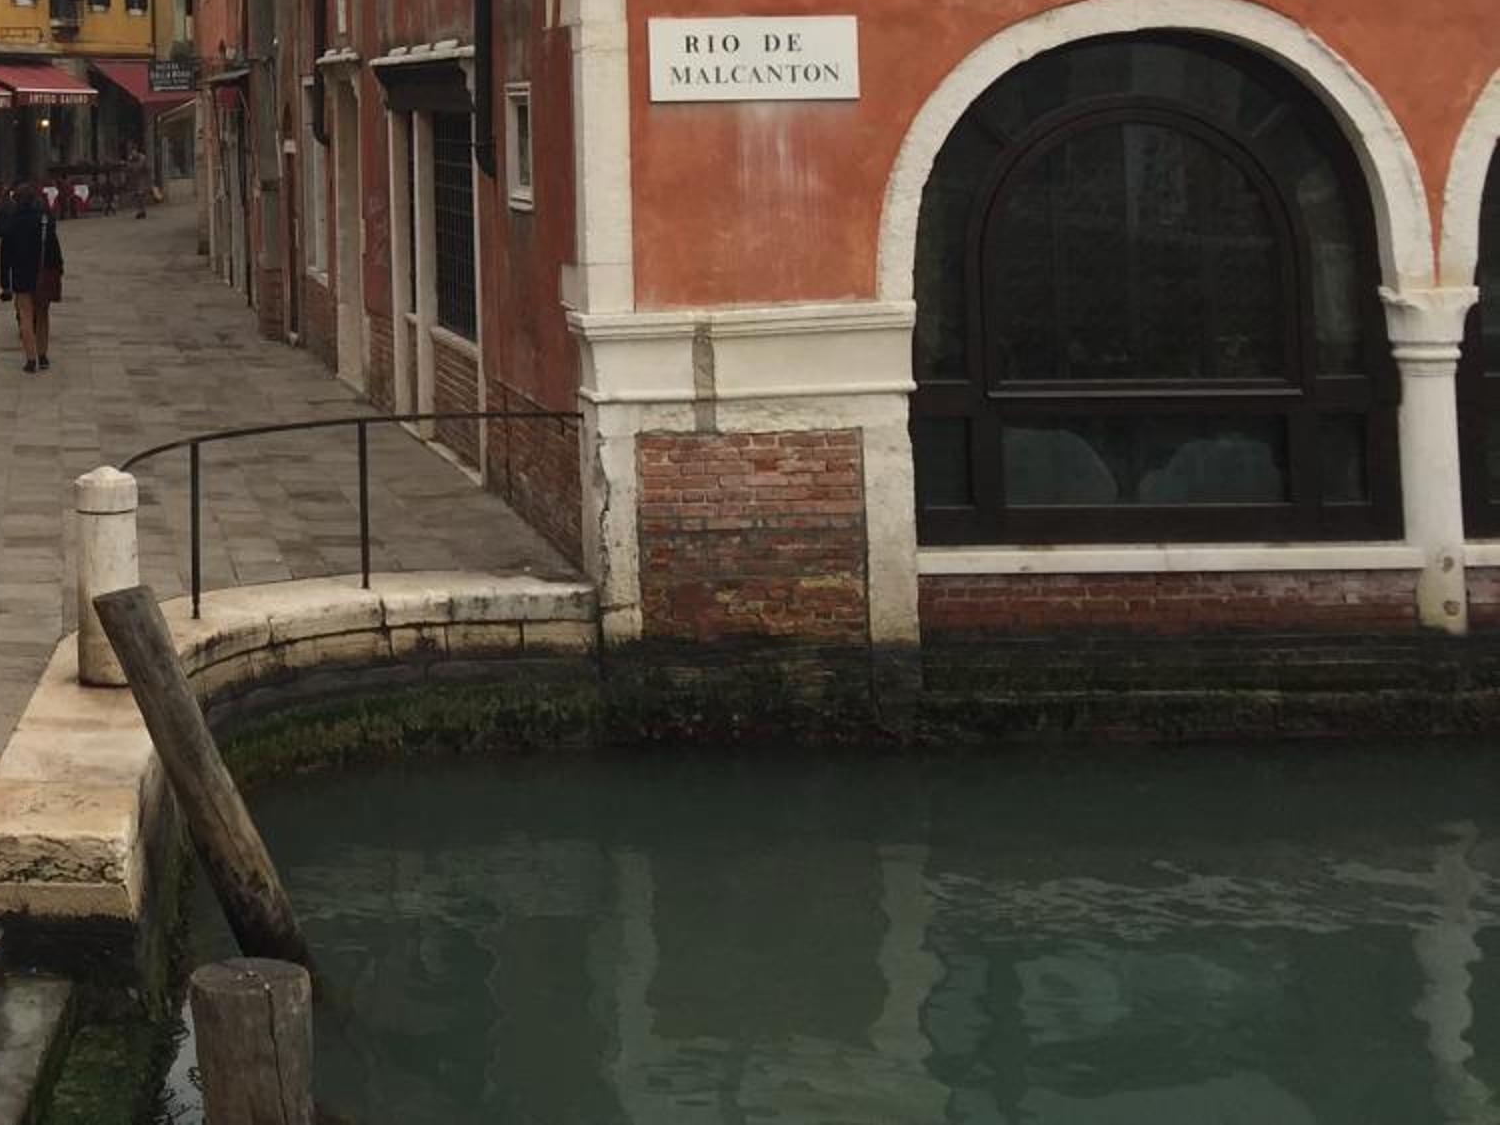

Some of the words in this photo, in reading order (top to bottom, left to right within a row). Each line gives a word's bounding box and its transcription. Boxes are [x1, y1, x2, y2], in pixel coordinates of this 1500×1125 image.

[684, 34, 740, 53] RIO
[764, 33, 803, 53] DE
[670, 63, 840, 85] MALCANTON
